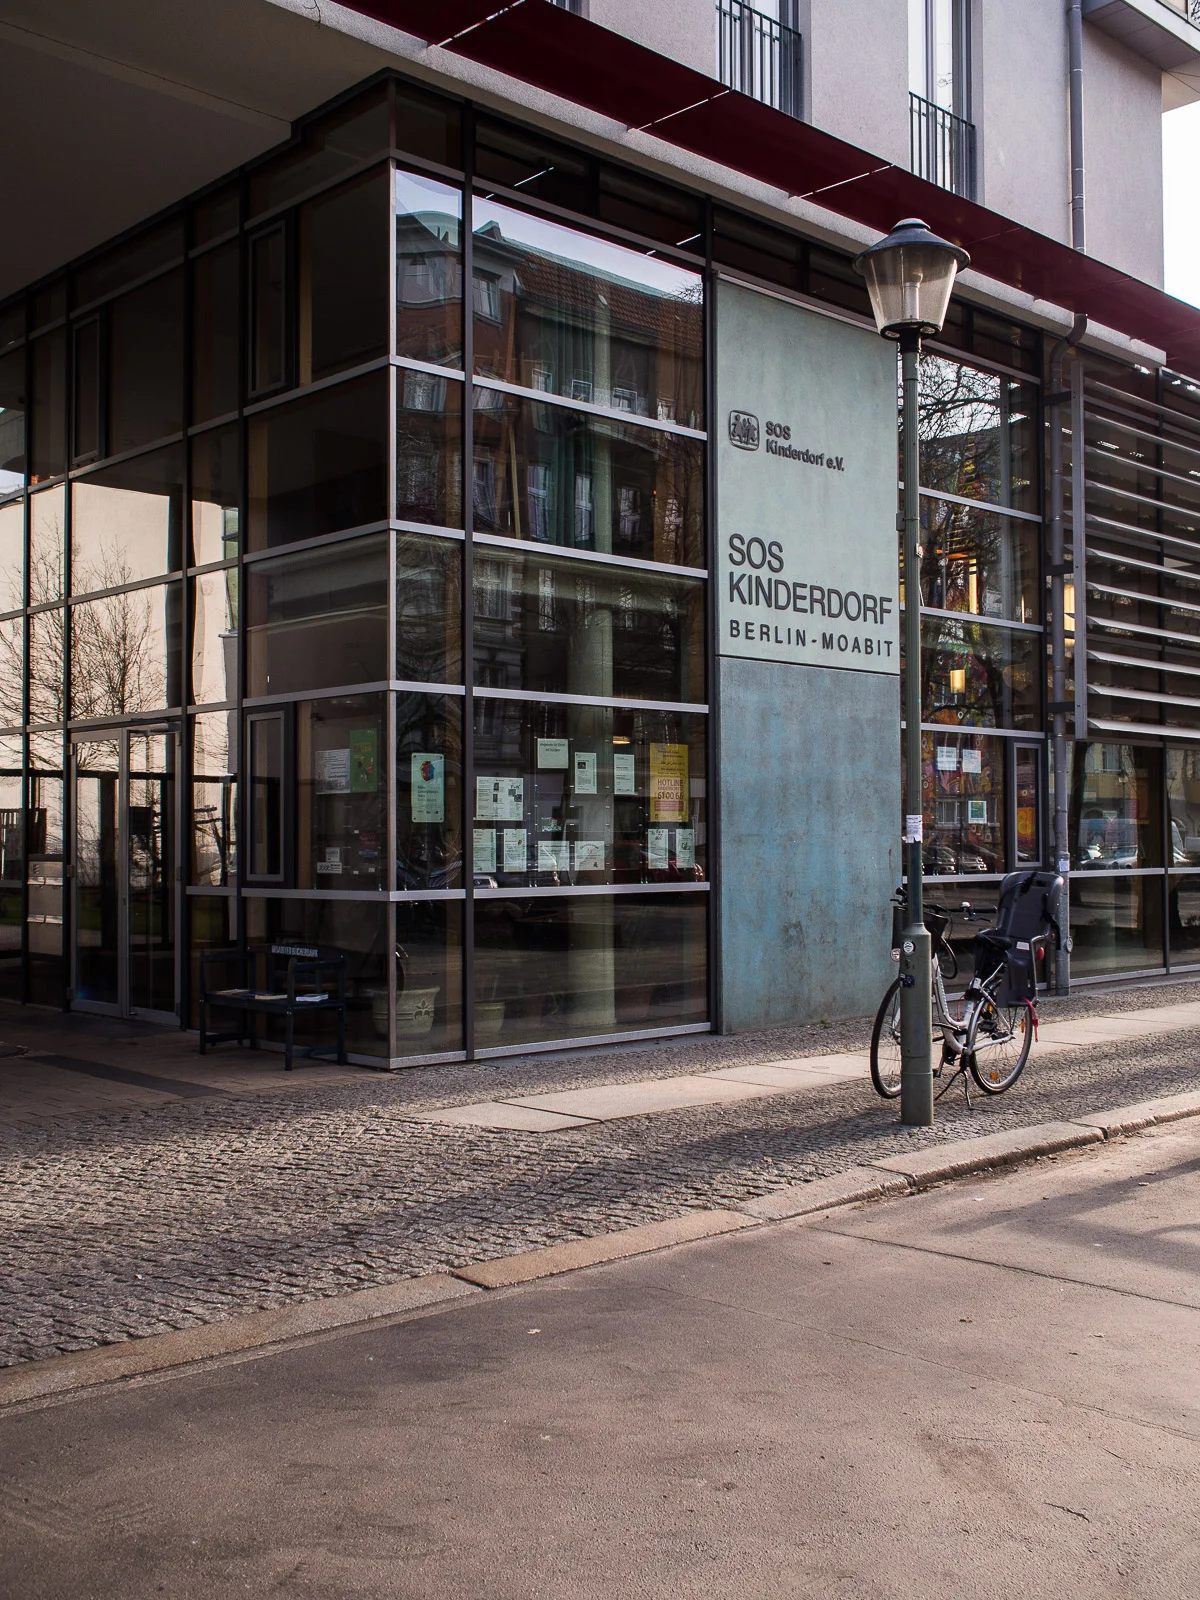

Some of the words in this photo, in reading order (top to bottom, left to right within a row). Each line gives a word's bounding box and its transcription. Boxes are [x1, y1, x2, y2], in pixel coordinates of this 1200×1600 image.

[765, 420, 792, 440] SOS
[766, 438, 825, 467] Kinderdorf
[826, 455, 845, 472] e.V.
[728, 533, 785, 573] SOS
[729, 571, 893, 625] KINDERDORF
[657, 778, 684, 787] HOTLINE
